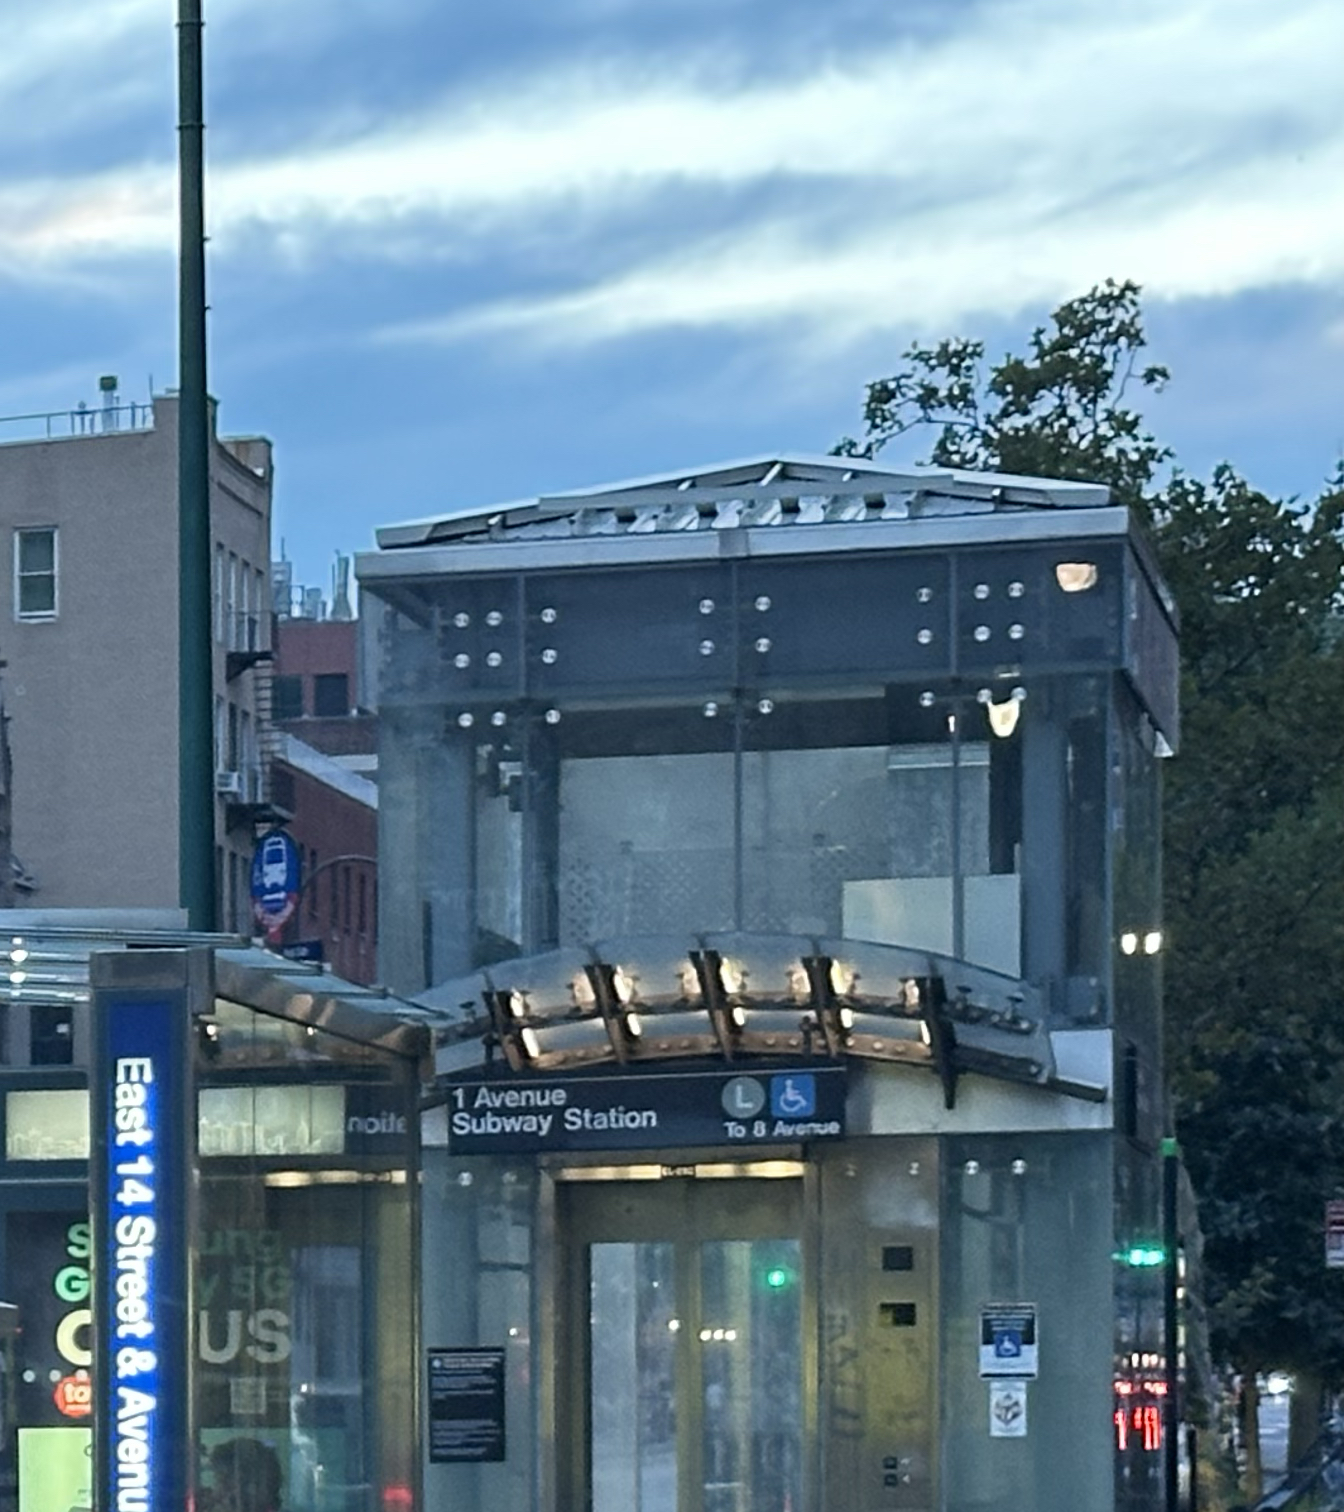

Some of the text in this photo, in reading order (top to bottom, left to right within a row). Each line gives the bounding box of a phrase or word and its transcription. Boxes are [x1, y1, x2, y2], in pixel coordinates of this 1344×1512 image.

[115, 1057, 154, 1147] East
[452, 1086, 567, 1108] 1 Avenue
[452, 1106, 657, 1137] Subway Station
[723, 1119, 841, 1137] To 8 Avenue
[116, 1154, 156, 1207] 14
[115, 1215, 157, 1339] Street
[116, 1346, 158, 1380] &
